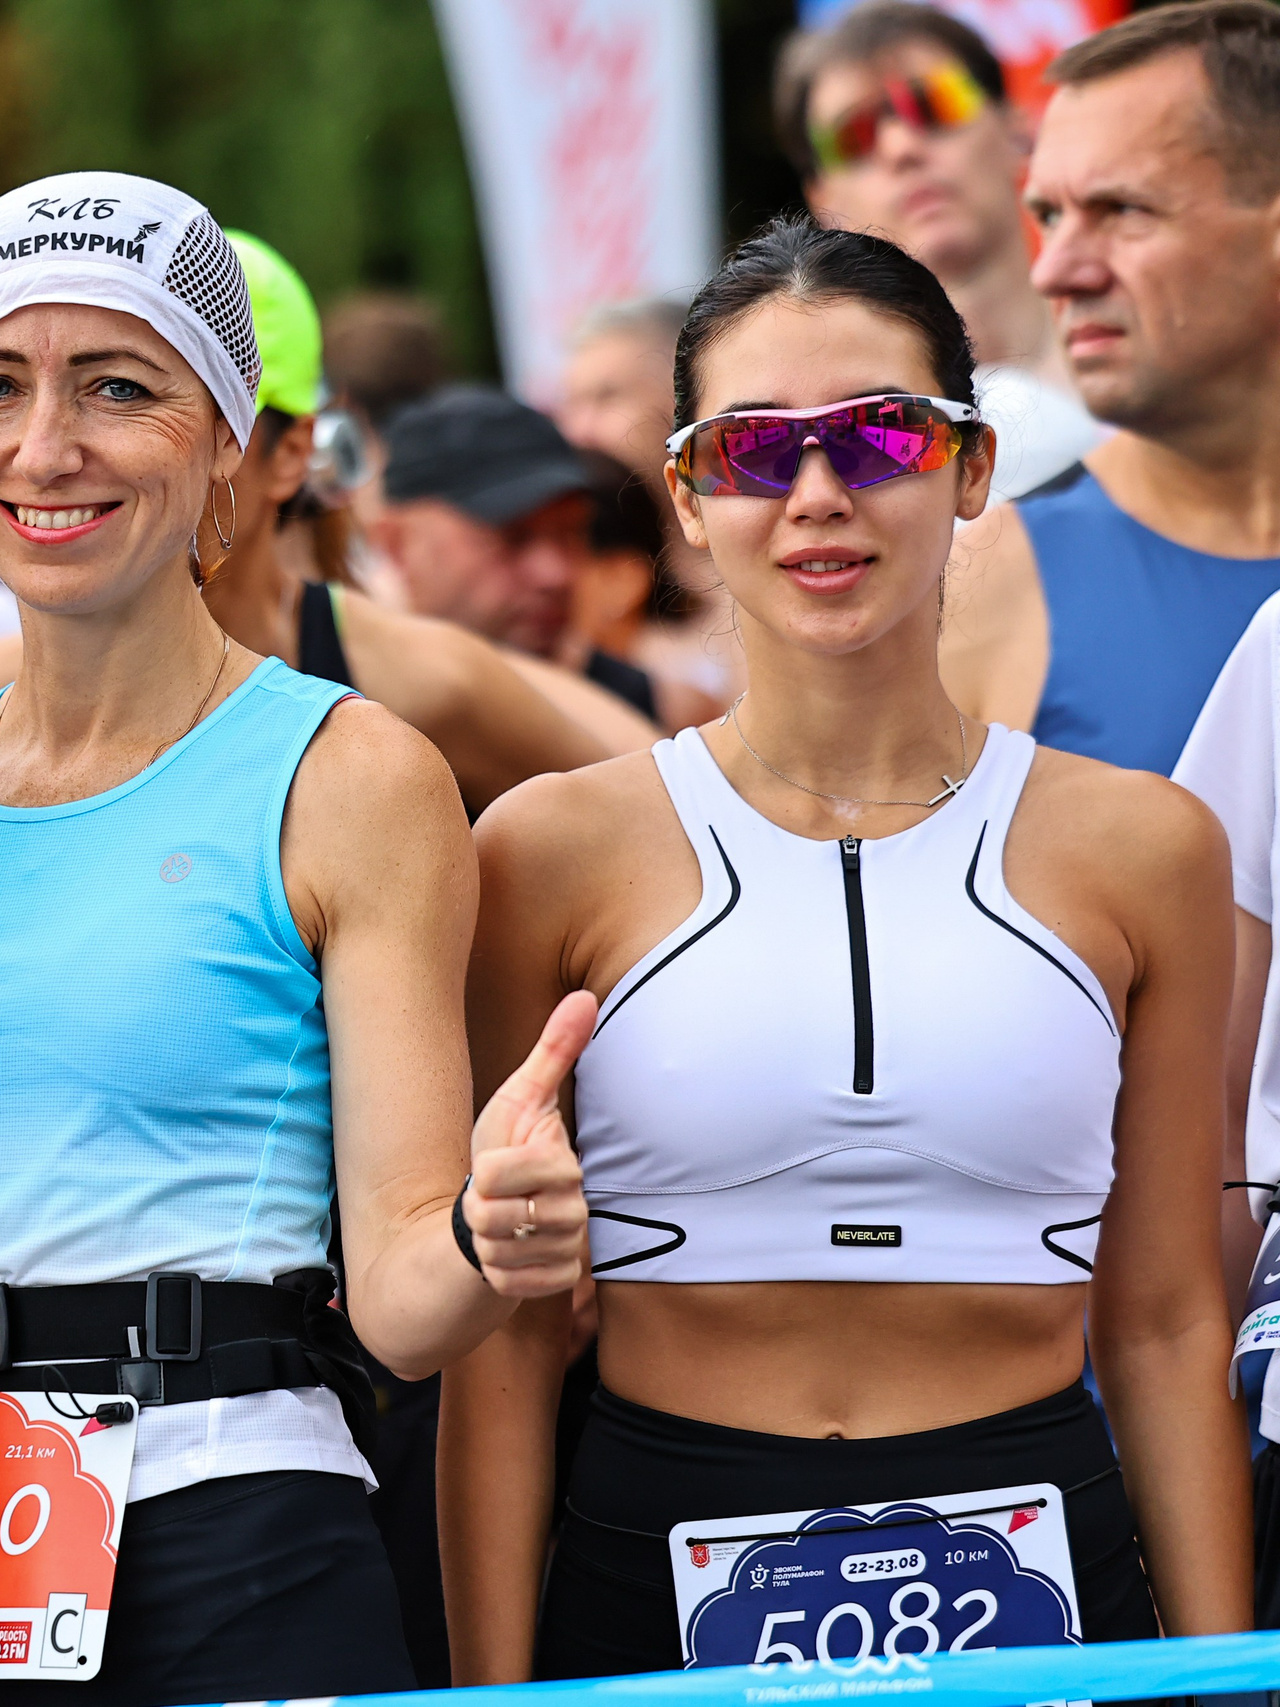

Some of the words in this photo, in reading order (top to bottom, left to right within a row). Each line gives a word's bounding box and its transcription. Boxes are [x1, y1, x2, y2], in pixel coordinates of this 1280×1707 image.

[836, 1230, 896, 1241] NEVERLATE
[1239, 1310, 1280, 1339] айга
[5, 1445, 34, 1461] 21,1
[847, 1553, 919, 1575] 22-23.08
[944, 1550, 965, 1566] 10
[772, 1569, 825, 1581] ПОЛУМАРАФОН
[773, 1565, 803, 1574] ЭВОКОМ
[772, 1580, 790, 1588] ТУЛА
[752, 1582, 999, 1664] 5082
[9, 1643, 27, 1659] FM
